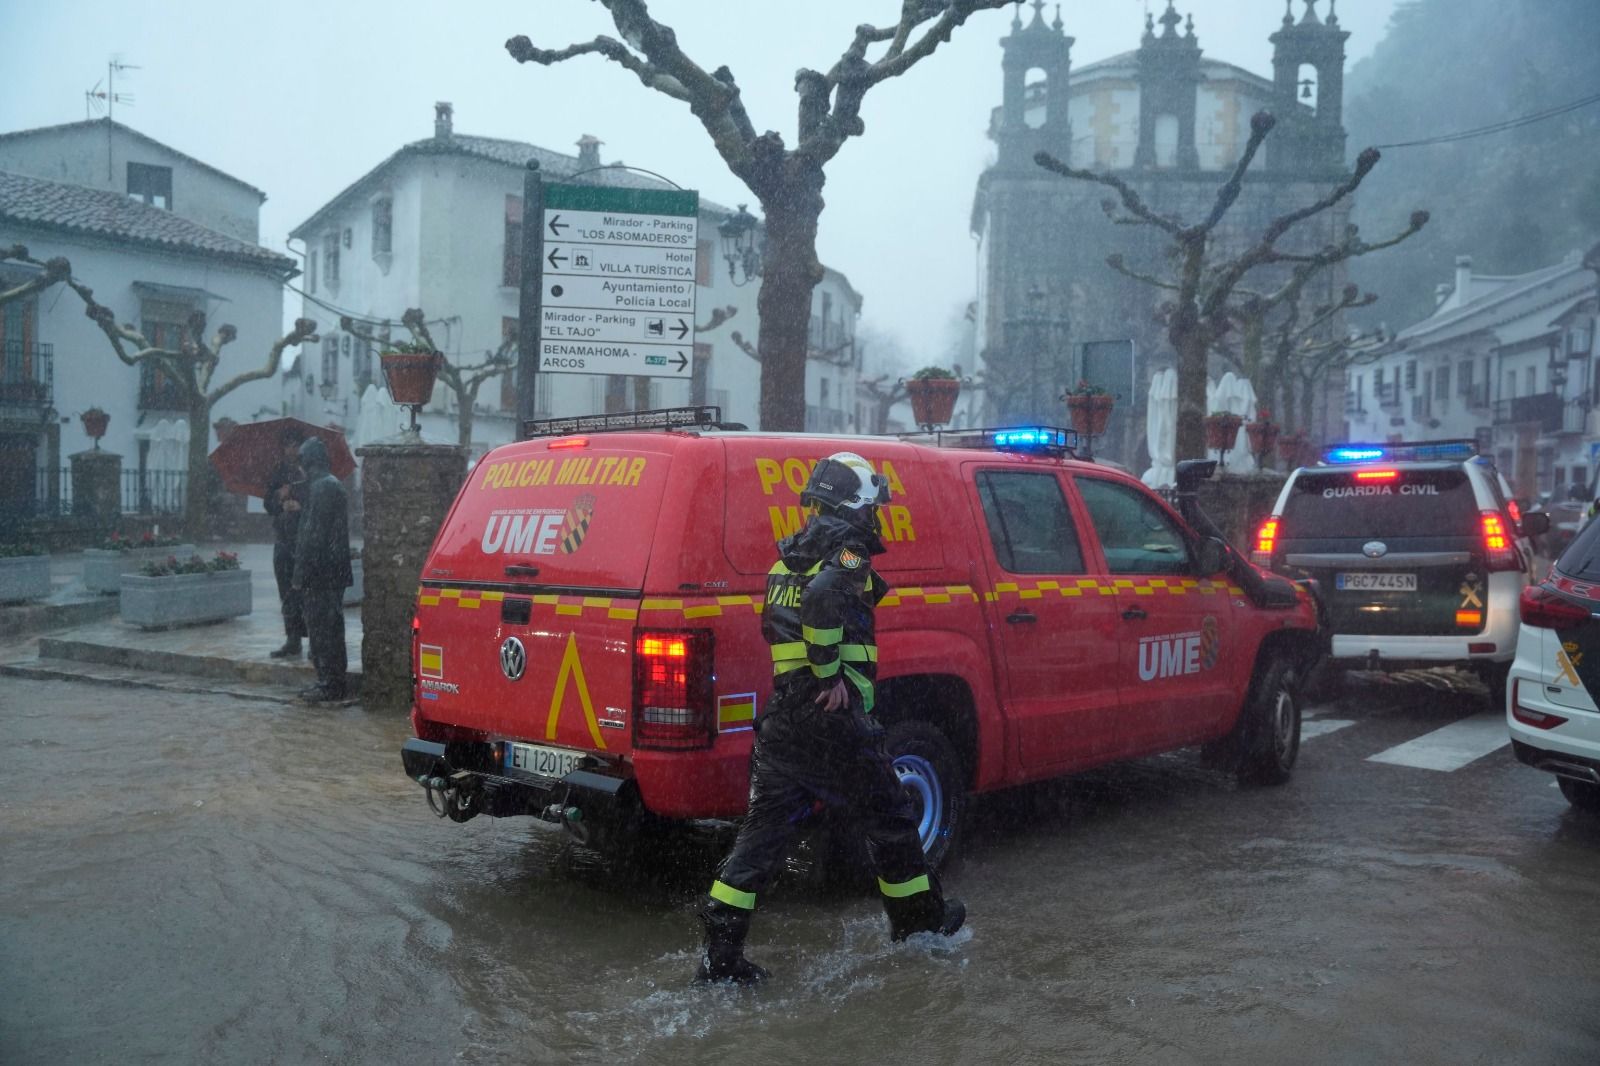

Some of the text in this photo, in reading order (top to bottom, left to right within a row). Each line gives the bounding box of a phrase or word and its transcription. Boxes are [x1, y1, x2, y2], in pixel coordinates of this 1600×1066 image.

[603, 217, 643, 228] Mirador
[653, 219, 693, 232] Parking
[577, 229, 693, 244] "LOS ASOMADEROS"
[666, 253, 693, 262] Hotel
[600, 263, 693, 276] VILLA TURÍSTICA
[602, 281, 685, 294] Ayuntamiento
[659, 297, 691, 308] Local
[544, 312, 586, 323] Mirador
[595, 314, 636, 327] Parking
[544, 325, 601, 337] "EL TAJO"
[543, 345, 630, 358] BENAMAHOMA
[543, 358, 585, 368] ARCOS
[480, 457, 646, 490] POLICIA MILITAR
[1323, 484, 1439, 498] GUARDIA CIVIL
[481, 515, 565, 555] UME
[768, 584, 801, 607] UME
[1139, 637, 1200, 681] UME
[513, 747, 530, 769] ET
